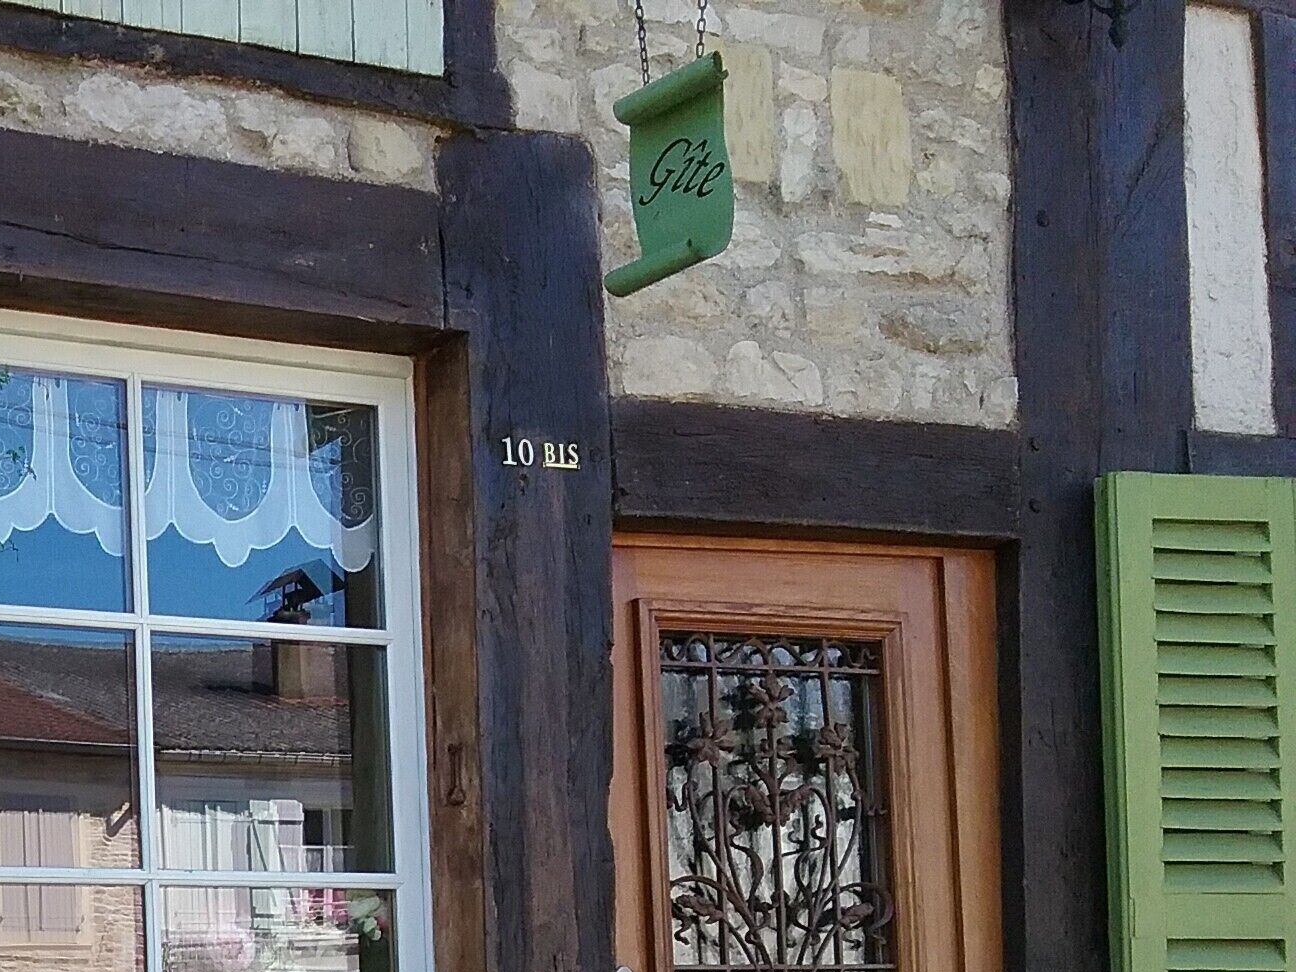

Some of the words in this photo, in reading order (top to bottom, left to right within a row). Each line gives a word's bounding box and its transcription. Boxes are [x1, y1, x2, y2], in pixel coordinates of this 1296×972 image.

[639, 138, 725, 206] Gîte
[501, 436, 534, 466] 10
[543, 442, 579, 466] BIS
